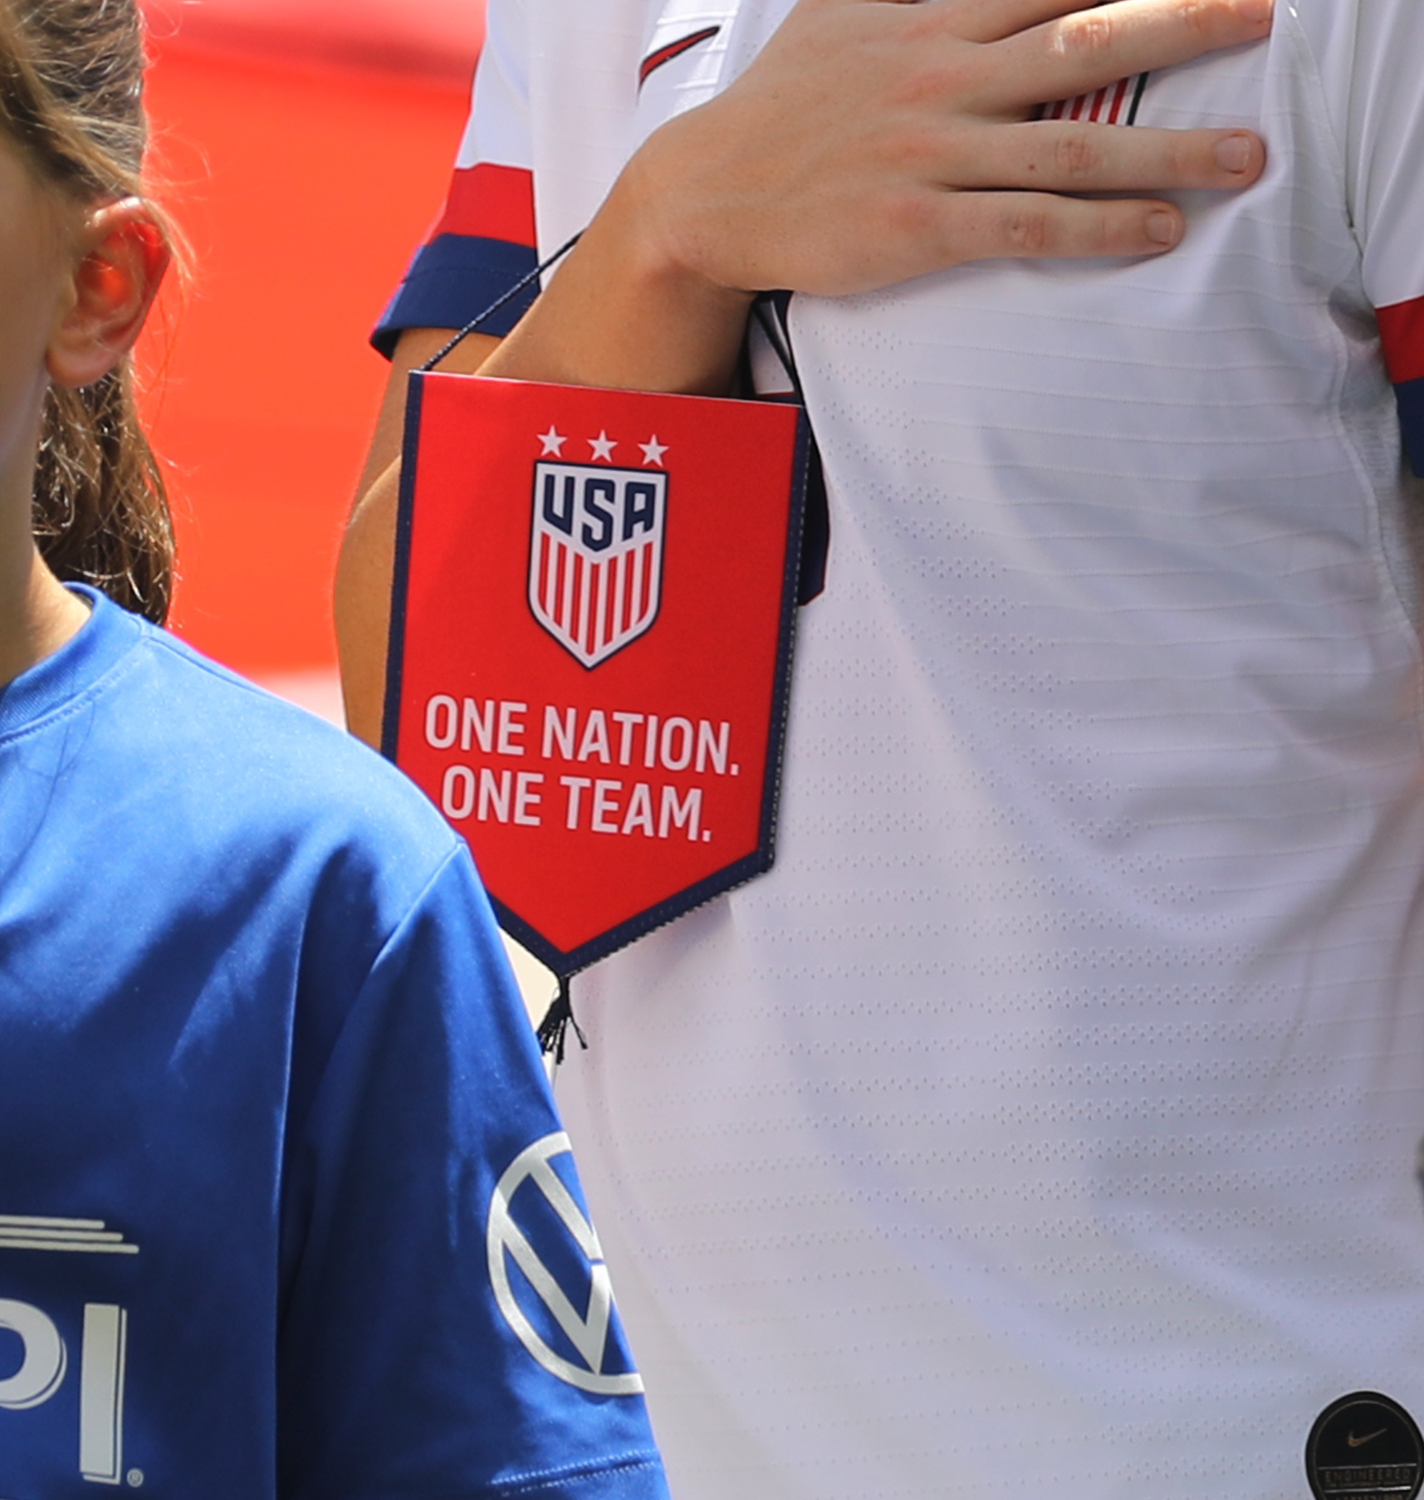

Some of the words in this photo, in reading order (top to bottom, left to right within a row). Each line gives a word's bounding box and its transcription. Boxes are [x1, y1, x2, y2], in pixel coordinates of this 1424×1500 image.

[541, 473, 656, 553] USA
[424, 694, 528, 756] ONE
[541, 704, 740, 776] NATION.
[440, 765, 545, 827] ONE
[558, 775, 712, 843] TEAM.
[1324, 1468, 1412, 1483] ENGINEERED
